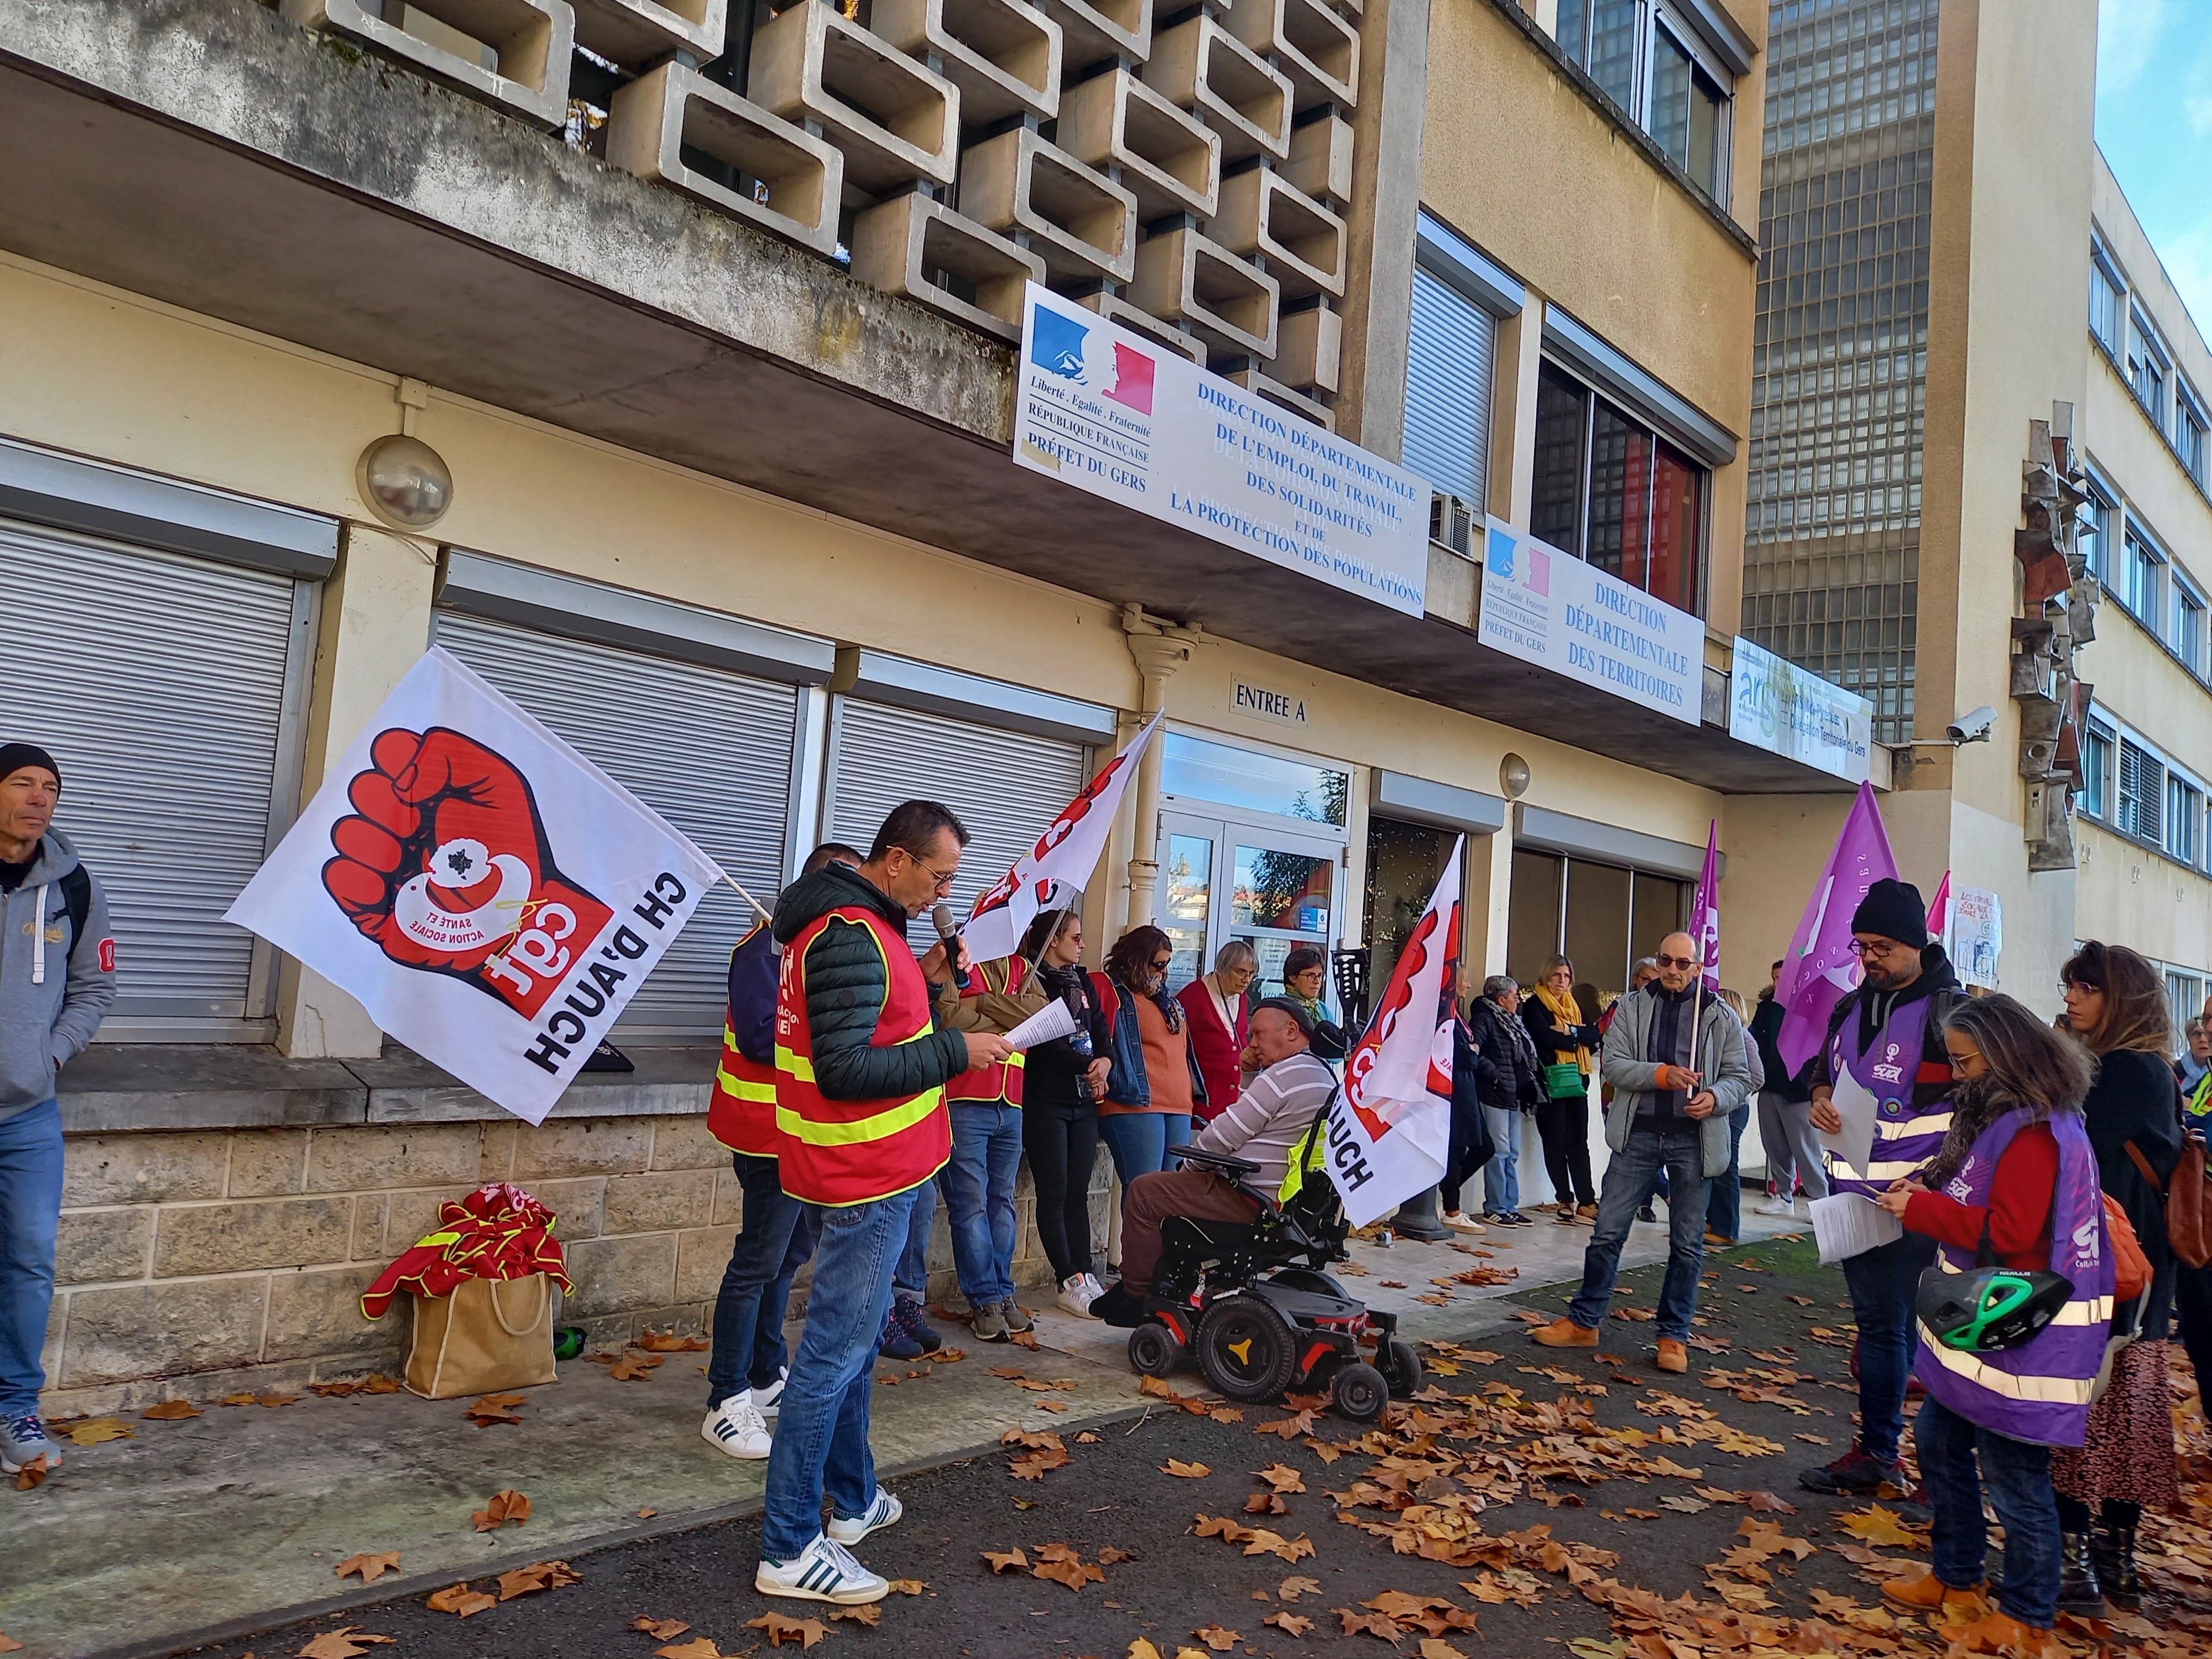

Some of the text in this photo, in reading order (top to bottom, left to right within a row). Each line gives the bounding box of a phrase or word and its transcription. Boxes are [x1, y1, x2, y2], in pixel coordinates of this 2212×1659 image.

[1029, 402, 1149, 463] RÉPUBLIQUE FRANÇAISE
[1031, 375, 1151, 437] Liberté Egalité Fraternité
[1028, 432, 1146, 493] PRÉFET DU GERS
[1197, 382, 1416, 502] DIRECTION DÉPARTEMENTALE
[1216, 422, 1238, 446] DE
[1322, 473, 1341, 492] DU
[1345, 483, 1402, 524] TRAVAIL,
[1246, 470, 1373, 538] DES SOLIDARITÉS
[1295, 520, 1326, 542] ET DE
[1171, 492, 1422, 606] LA PROTECTION DES POPULATIONS
[1486, 598, 1547, 632] RÉPUBLIQUE FRANÇAISE
[1487, 579, 1504, 594] Liberté
[1595, 582, 1666, 634] DIRECTION
[1485, 619, 1546, 654] PRÉFET DU GERS
[1565, 604, 1687, 676] DÉPARTEMENTALE
[1237, 684, 1305, 721] ENTREE A
[1568, 642, 1682, 706] DES TERRITOIRES
[1739, 672, 1776, 738] ars
[1820, 726, 1846, 749] Territoriale
[1847, 739, 1854, 753] du
[1855, 741, 1865, 758] Gers
